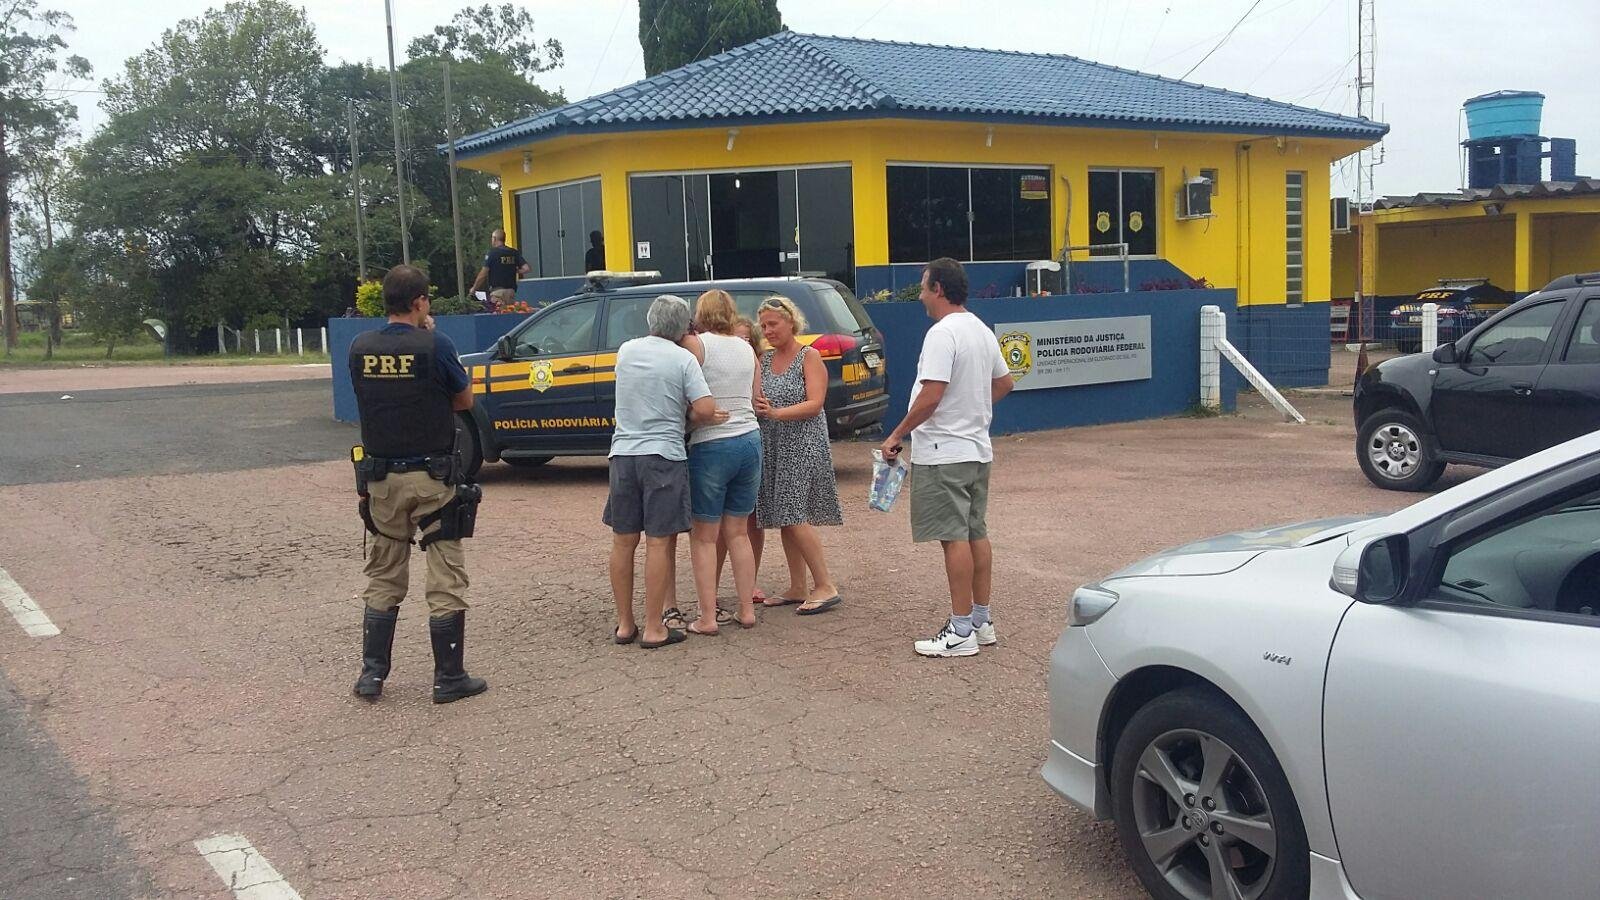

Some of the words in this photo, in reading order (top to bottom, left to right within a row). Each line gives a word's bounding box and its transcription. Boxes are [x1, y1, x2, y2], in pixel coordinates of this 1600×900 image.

[1417, 292, 1454, 300] PRF
[1084, 335, 1094, 343] DA
[1095, 333, 1125, 342] JUSTIÇA
[1116, 342, 1146, 352] FEDERAL
[363, 354, 415, 373] PRF
[494, 418, 539, 429] POLÍCIA
[540, 416, 610, 428] RODOVIÁRIA
